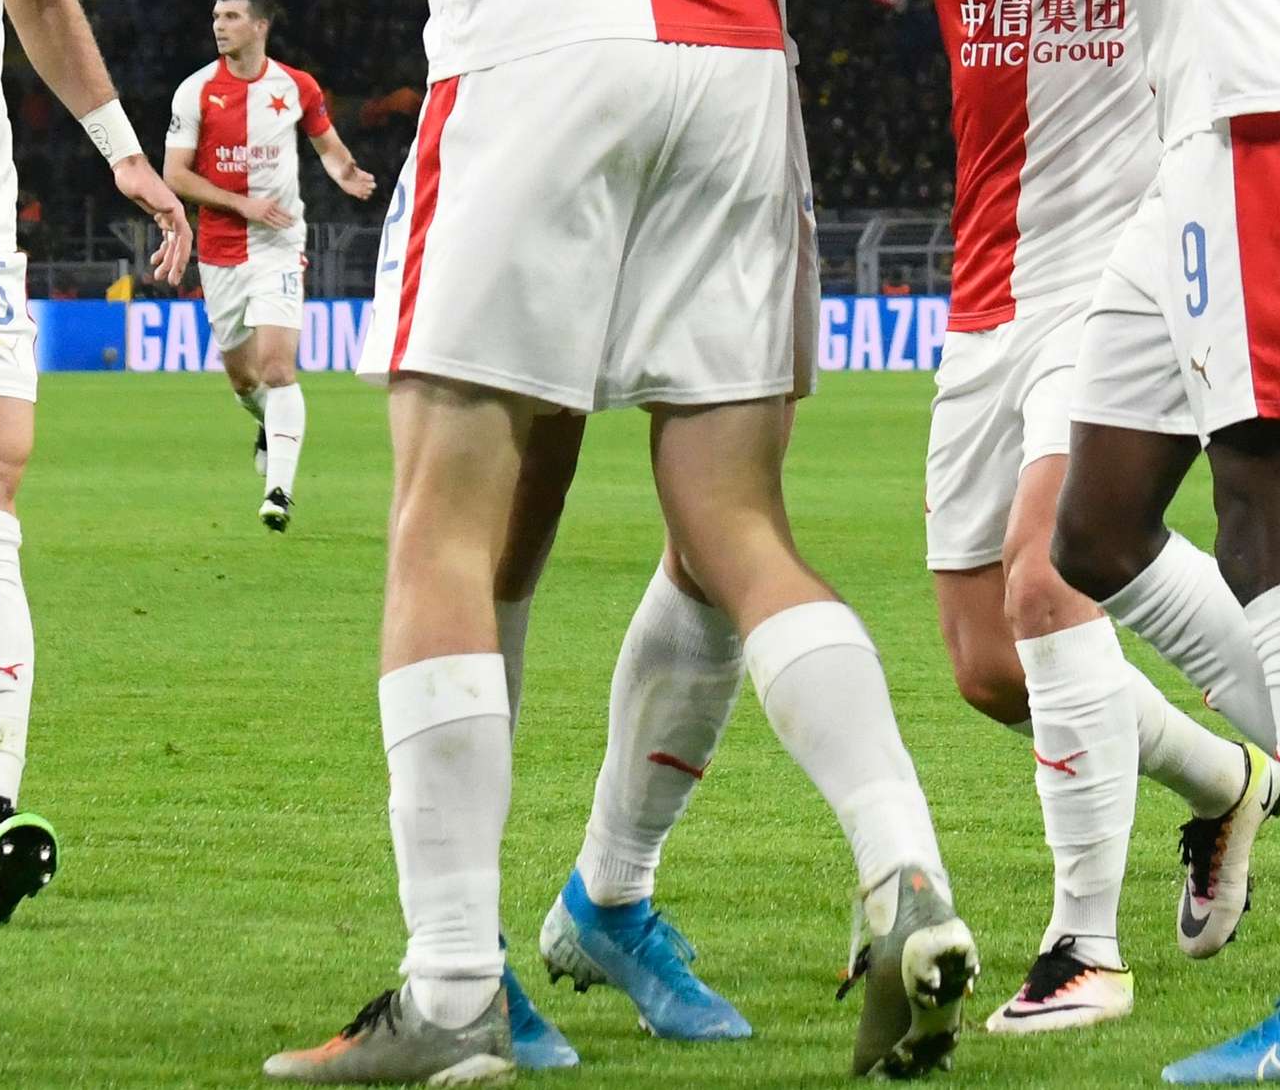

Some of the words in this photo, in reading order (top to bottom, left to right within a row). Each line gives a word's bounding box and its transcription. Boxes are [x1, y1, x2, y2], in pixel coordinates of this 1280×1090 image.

[959, 41, 1025, 68] CITIC
[1032, 39, 1125, 68] Group
[1181, 220, 1210, 318] 9
[127, 300, 373, 372] GAOM
[818, 296, 949, 371] GAZP
